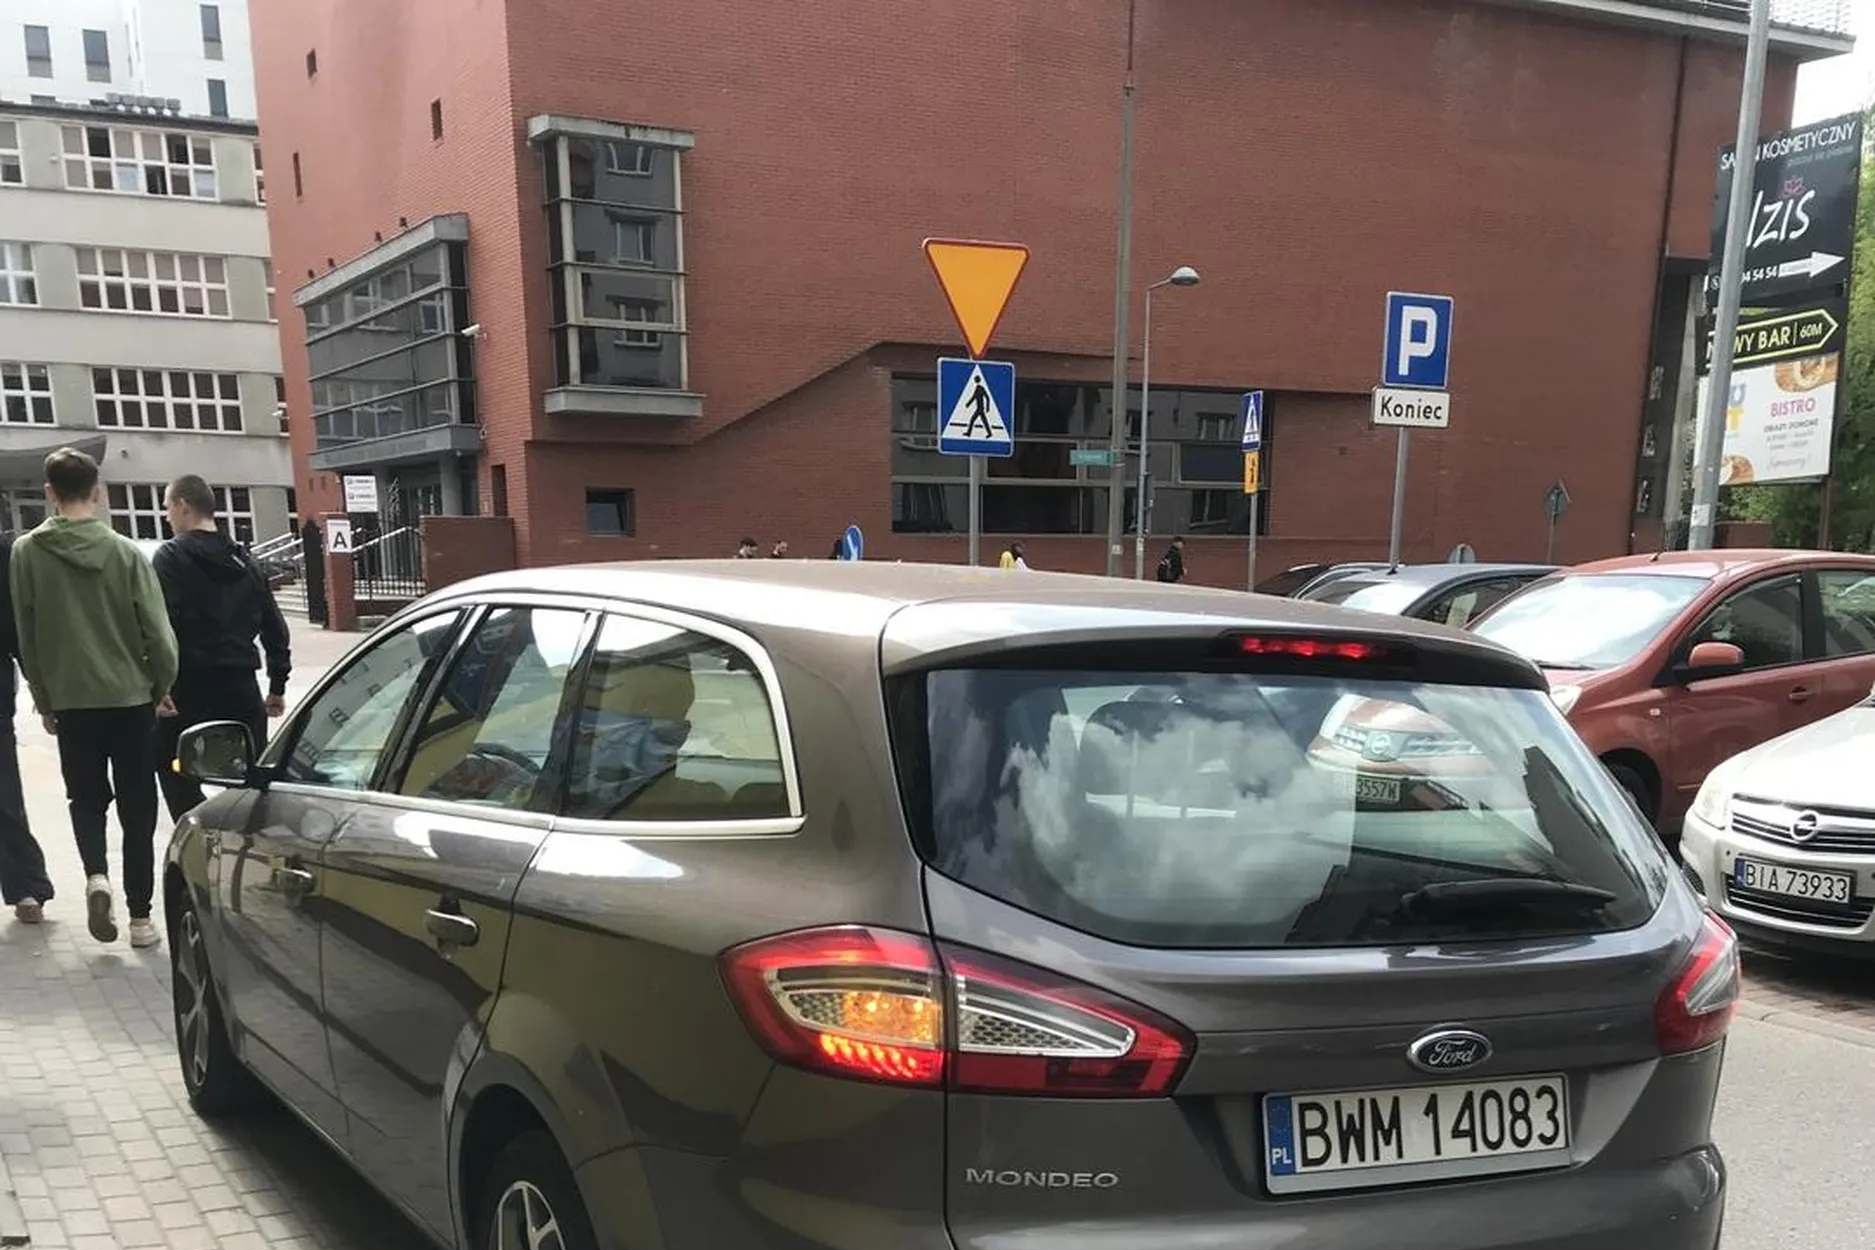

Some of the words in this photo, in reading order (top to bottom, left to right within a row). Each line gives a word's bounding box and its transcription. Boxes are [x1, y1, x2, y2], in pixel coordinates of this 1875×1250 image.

[1762, 121, 1857, 161] KOSMETYCZNY
[1746, 190, 1815, 248] IZIS
[1752, 267, 1764, 281] 54
[1765, 265, 1777, 279] 54
[1398, 305, 1437, 376] P
[1706, 333, 1754, 359] NWY
[1758, 326, 1791, 349] BAR
[1800, 322, 1822, 338] 60M
[1380, 396, 1442, 420] Koniec
[1770, 398, 1816, 417] BISTRO
[333, 531, 348, 549] A
[1746, 864, 1779, 891] BIA
[1785, 870, 1848, 901] 73933
[1429, 1040, 1477, 1065] Ford
[1298, 1095, 1403, 1168] BWM
[1422, 1084, 1561, 1156] 14083
[1271, 1148, 1292, 1166] PL
[965, 1168, 1119, 1188] MONDEO
